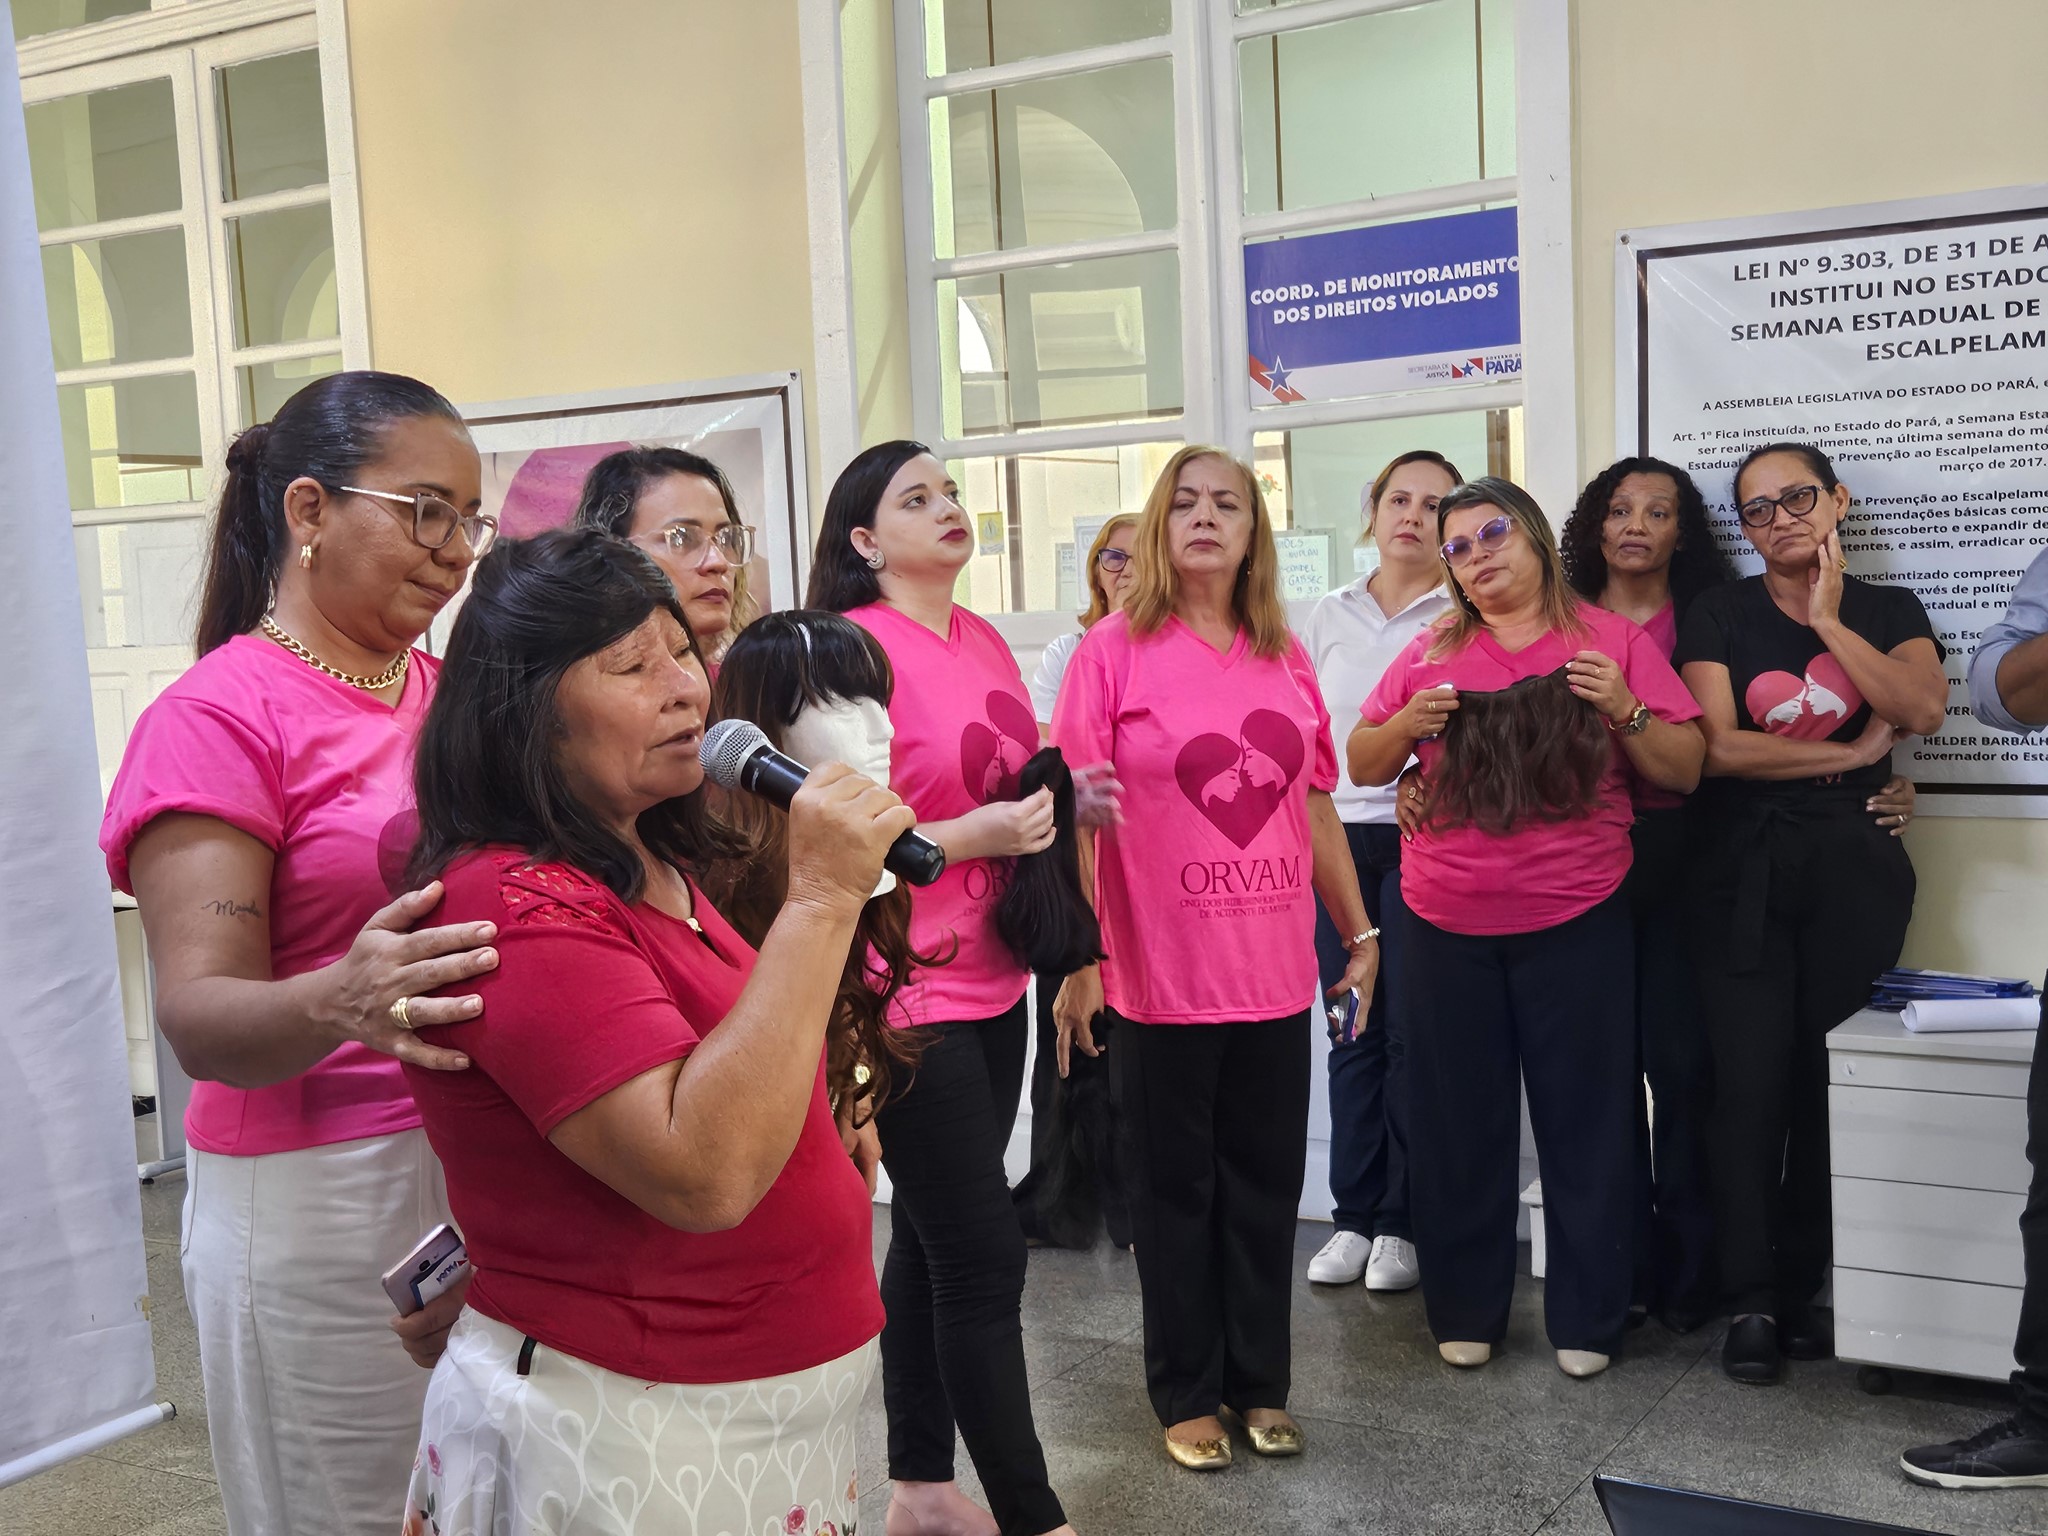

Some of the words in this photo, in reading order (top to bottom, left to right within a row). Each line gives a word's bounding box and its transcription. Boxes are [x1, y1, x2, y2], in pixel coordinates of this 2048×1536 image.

[1734, 262, 1769, 282] LEI
[1817, 250, 1894, 274] 9.303,
[1904, 245, 1938, 265] DE
[1947, 241, 1976, 261] 31
[1988, 236, 2024, 256] DE
[1250, 283, 1320, 305] COORD.
[1324, 278, 1347, 296] DE
[1351, 255, 1519, 293] MONITORAMENTO
[1770, 281, 1882, 308] INSTITUI
[1893, 276, 1936, 297] NO
[1273, 306, 1311, 325] DOS
[1314, 295, 1397, 320] DIREITOS
[1400, 282, 1499, 309] VIOLADOS
[1730, 316, 1844, 341] SEMANA
[1852, 303, 1995, 331] ESTADUAL
[2005, 299, 2040, 319] DE
[1866, 330, 2046, 361] ESCALPELAM
[1702, 401, 1712, 411] A
[1714, 396, 1794, 410] ASSEMBLEIA
[1797, 390, 1883, 404] LEGISLATIVA
[1886, 388, 1907, 399] DO
[1911, 384, 1967, 397] ESTADO
[1970, 382, 1992, 393] DO
[1997, 376, 2039, 391] PARÁ,
[1672, 433, 1696, 442] Art.
[1715, 429, 1740, 440] Fica
[1743, 425, 1809, 438] instituída,
[1813, 425, 1830, 434] no
[1834, 420, 1880, 432] Estado
[1884, 419, 1902, 429] do
[1905, 416, 1941, 428] Pará,
[1945, 417, 1954, 425] a
[1957, 413, 2015, 425] Semana
[1697, 446, 1717, 455] ser
[1720, 441, 1771, 453] realizad
[1800, 436, 1871, 448] ualmente,
[1876, 436, 1893, 445] na
[1897, 432, 1943, 444] última
[1947, 429, 2004, 440] semana
[2007, 426, 2026, 437] do
[1688, 457, 1742, 471] Estadual
[1838, 449, 1911, 463] Prevenção
[1914, 449, 1932, 458] ao
[1936, 442, 2048, 458] Escalpelamento
[1939, 461, 1984, 473] março
[1988, 459, 2005, 469] de
[2009, 457, 2047, 468] 2017.
[1717, 503, 1727, 513] A
[1865, 493, 1937, 507] Prevenção
[1941, 493, 1958, 503] ao
[1954, 505, 2007, 518] básicas
[2011, 505, 2048, 515] como
[1870, 523, 1948, 536] descoberto
[1951, 524, 1960, 533] e
[1964, 519, 2029, 535] expandir
[1840, 542, 1894, 552] etentes,
[1898, 541, 1907, 550] e
[1910, 538, 1954, 550] assim,
[1958, 536, 2025, 549] erradicar
[2029, 537, 2048, 546] oc
[1951, 584, 1969, 594] de
[1924, 599, 1977, 610] stadual
[1981, 600, 1990, 609] e
[1939, 630, 1957, 641] ao
[1923, 736, 1977, 746] HELDER
[1981, 736, 2048, 747] BARBALH
[1913, 751, 1997, 761] Governador
[2001, 751, 2018, 762] do
[1180, 855, 1301, 895] ORVAM
